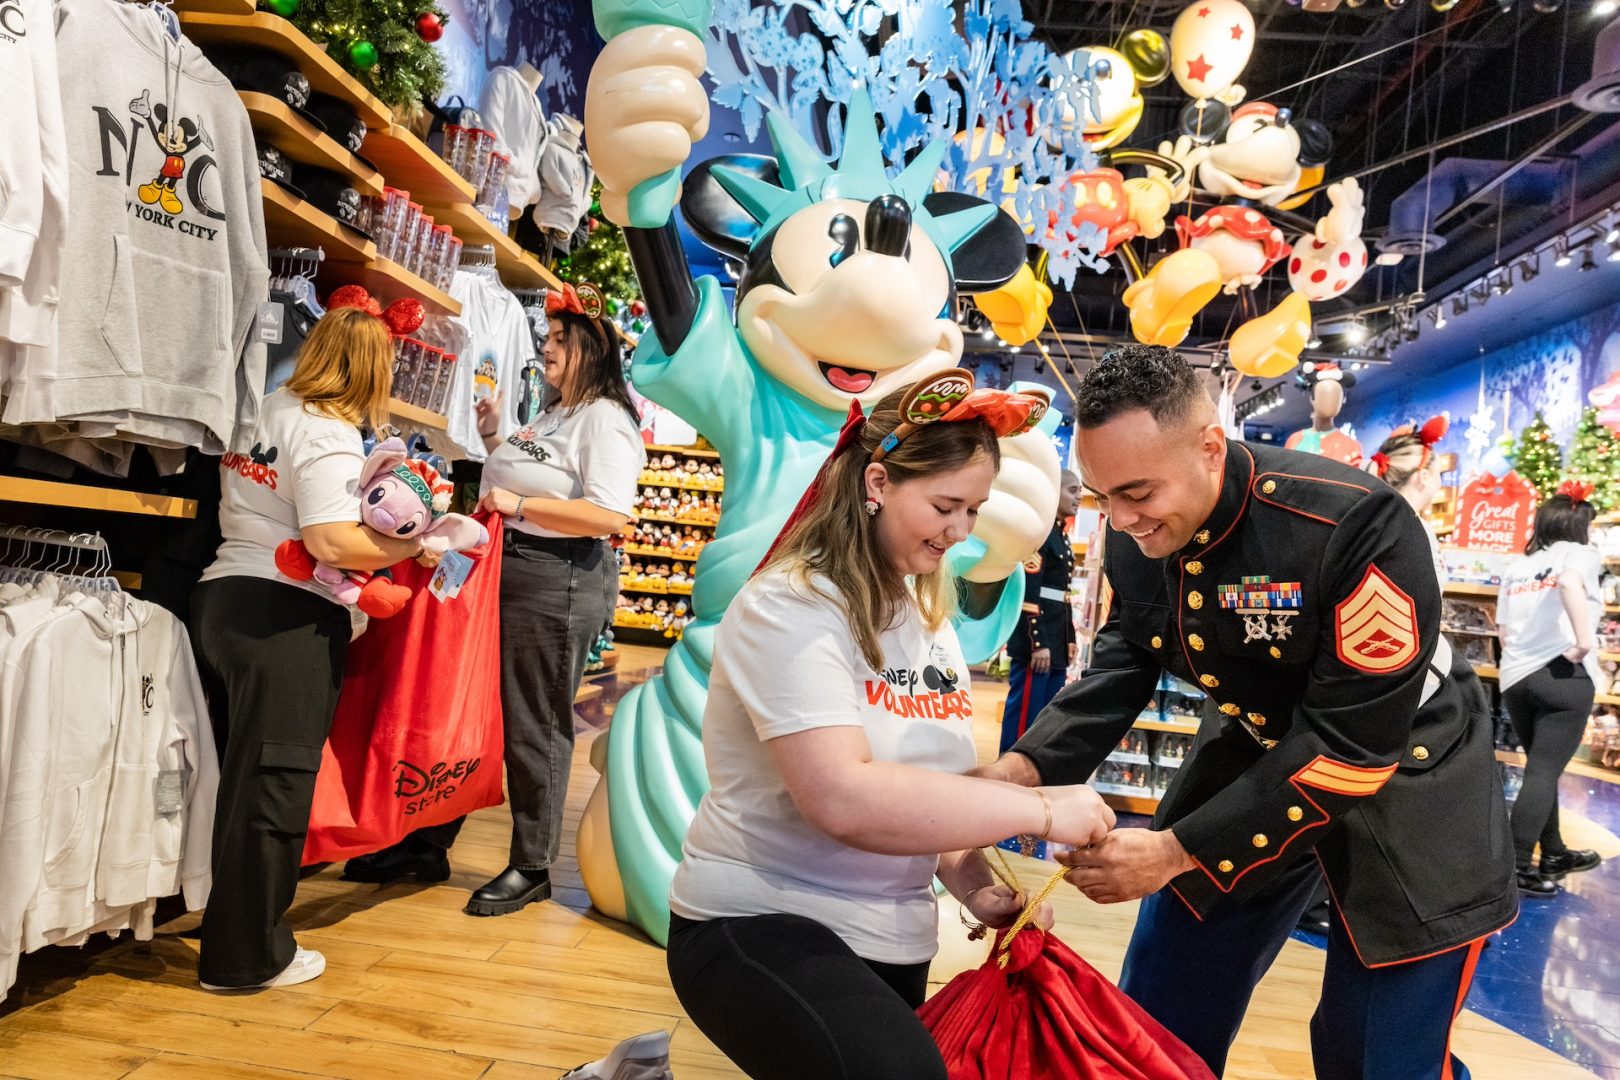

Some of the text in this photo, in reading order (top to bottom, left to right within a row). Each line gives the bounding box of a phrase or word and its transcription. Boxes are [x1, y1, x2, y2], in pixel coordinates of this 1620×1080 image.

[135, 204, 218, 241] YORK CITY
[1469, 500, 1520, 530] Great
[1482, 519, 1516, 531] GIFTS
[1467, 542, 1514, 552] MAGIC
[1469, 530, 1514, 543] MORE
[865, 680, 972, 720] VOLUNTEARS
